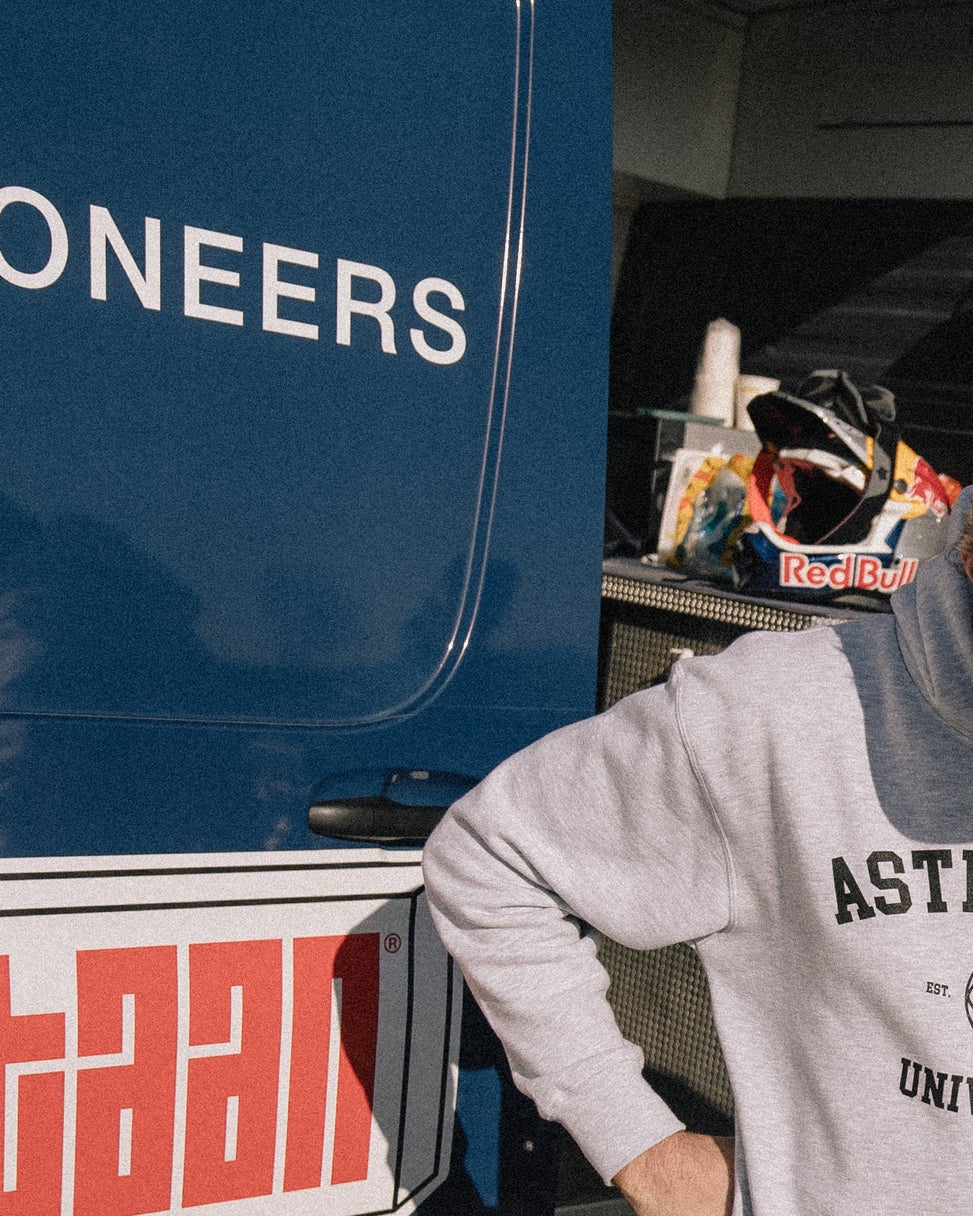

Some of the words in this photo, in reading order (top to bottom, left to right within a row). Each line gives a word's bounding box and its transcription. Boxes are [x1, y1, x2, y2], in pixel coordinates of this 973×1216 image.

[0, 186, 467, 366] ONEERS
[779, 551, 855, 588] Red
[855, 555, 918, 592] Bull
[926, 980, 951, 998] EST.
